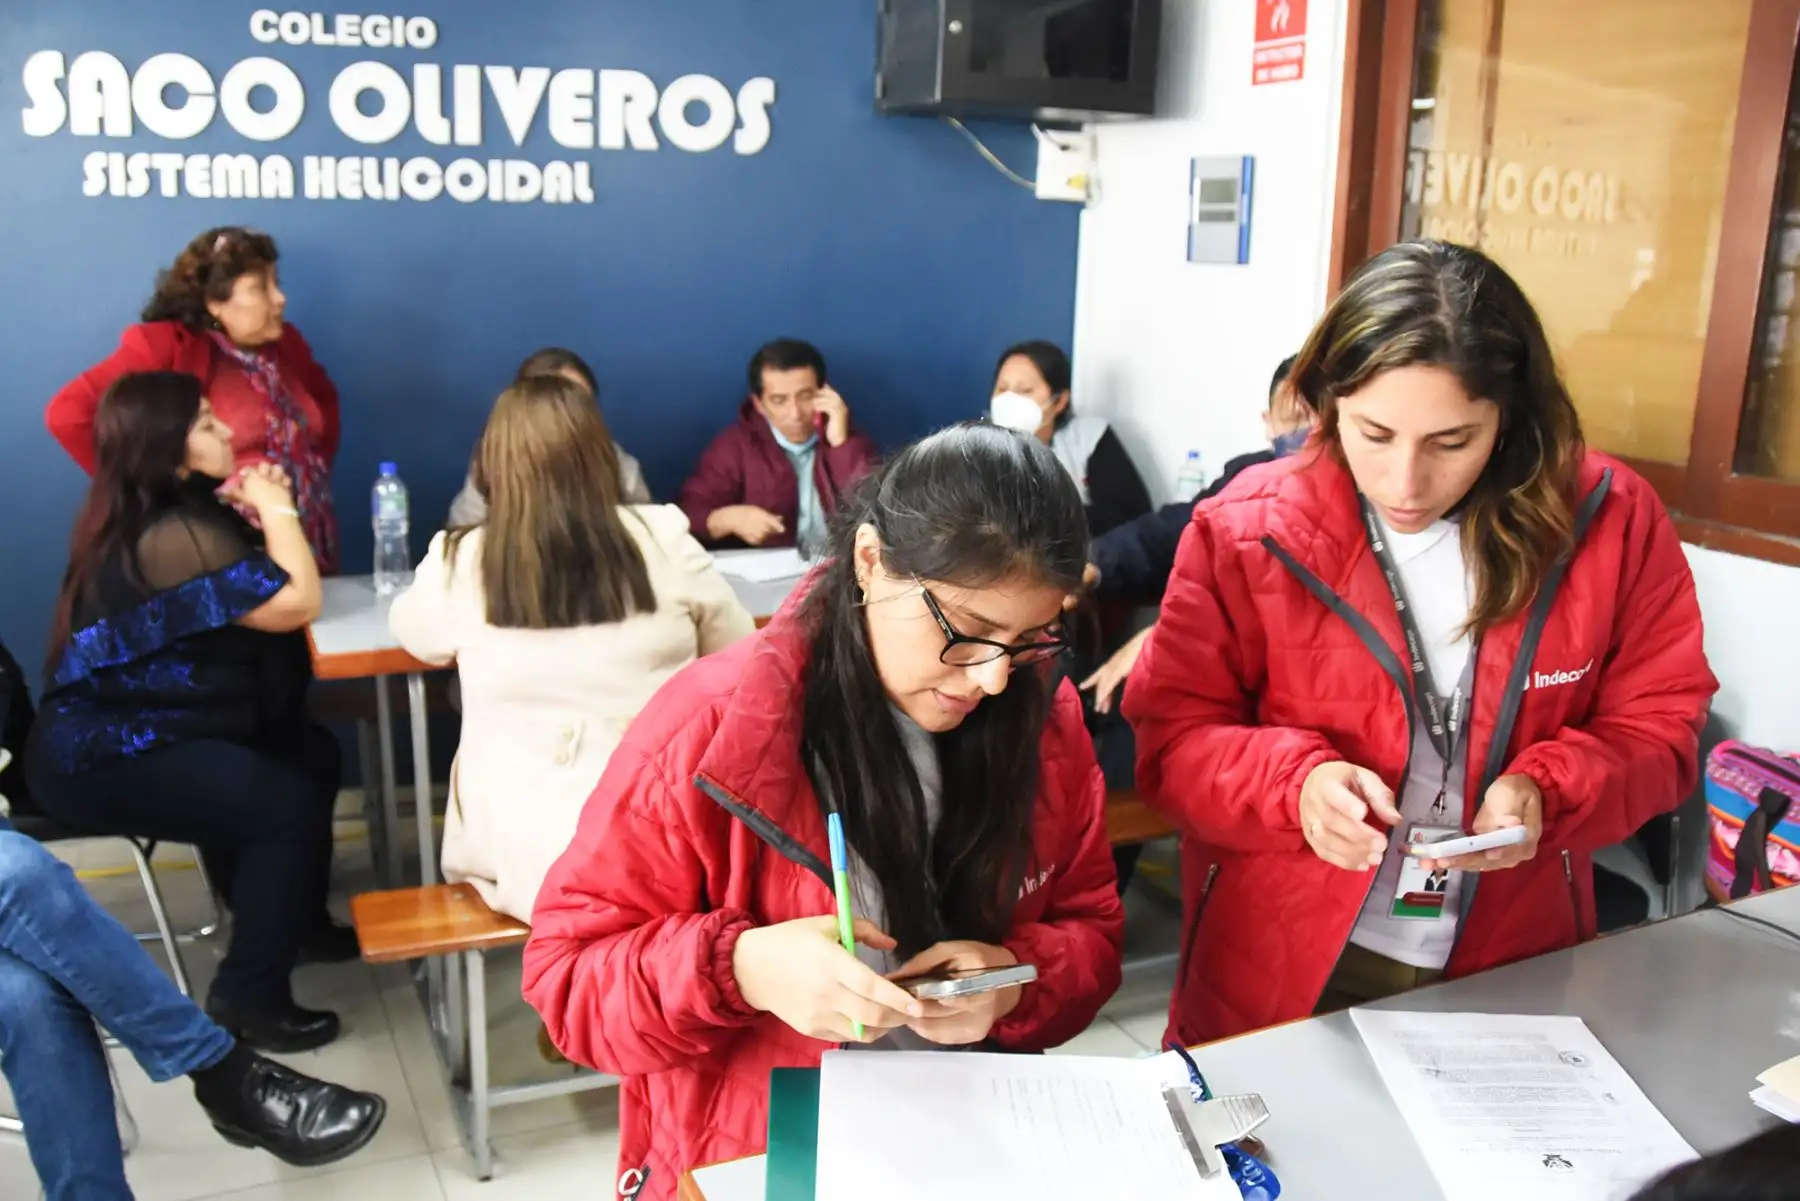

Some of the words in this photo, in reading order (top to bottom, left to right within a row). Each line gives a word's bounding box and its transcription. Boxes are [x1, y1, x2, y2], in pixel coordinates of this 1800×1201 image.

[250, 9, 437, 48] COLEGIO
[20, 49, 304, 141] SACO
[328, 61, 775, 155] OLIVEROS
[82, 150, 294, 200] SISTEMA
[303, 154, 595, 203] HELICOIDAL
